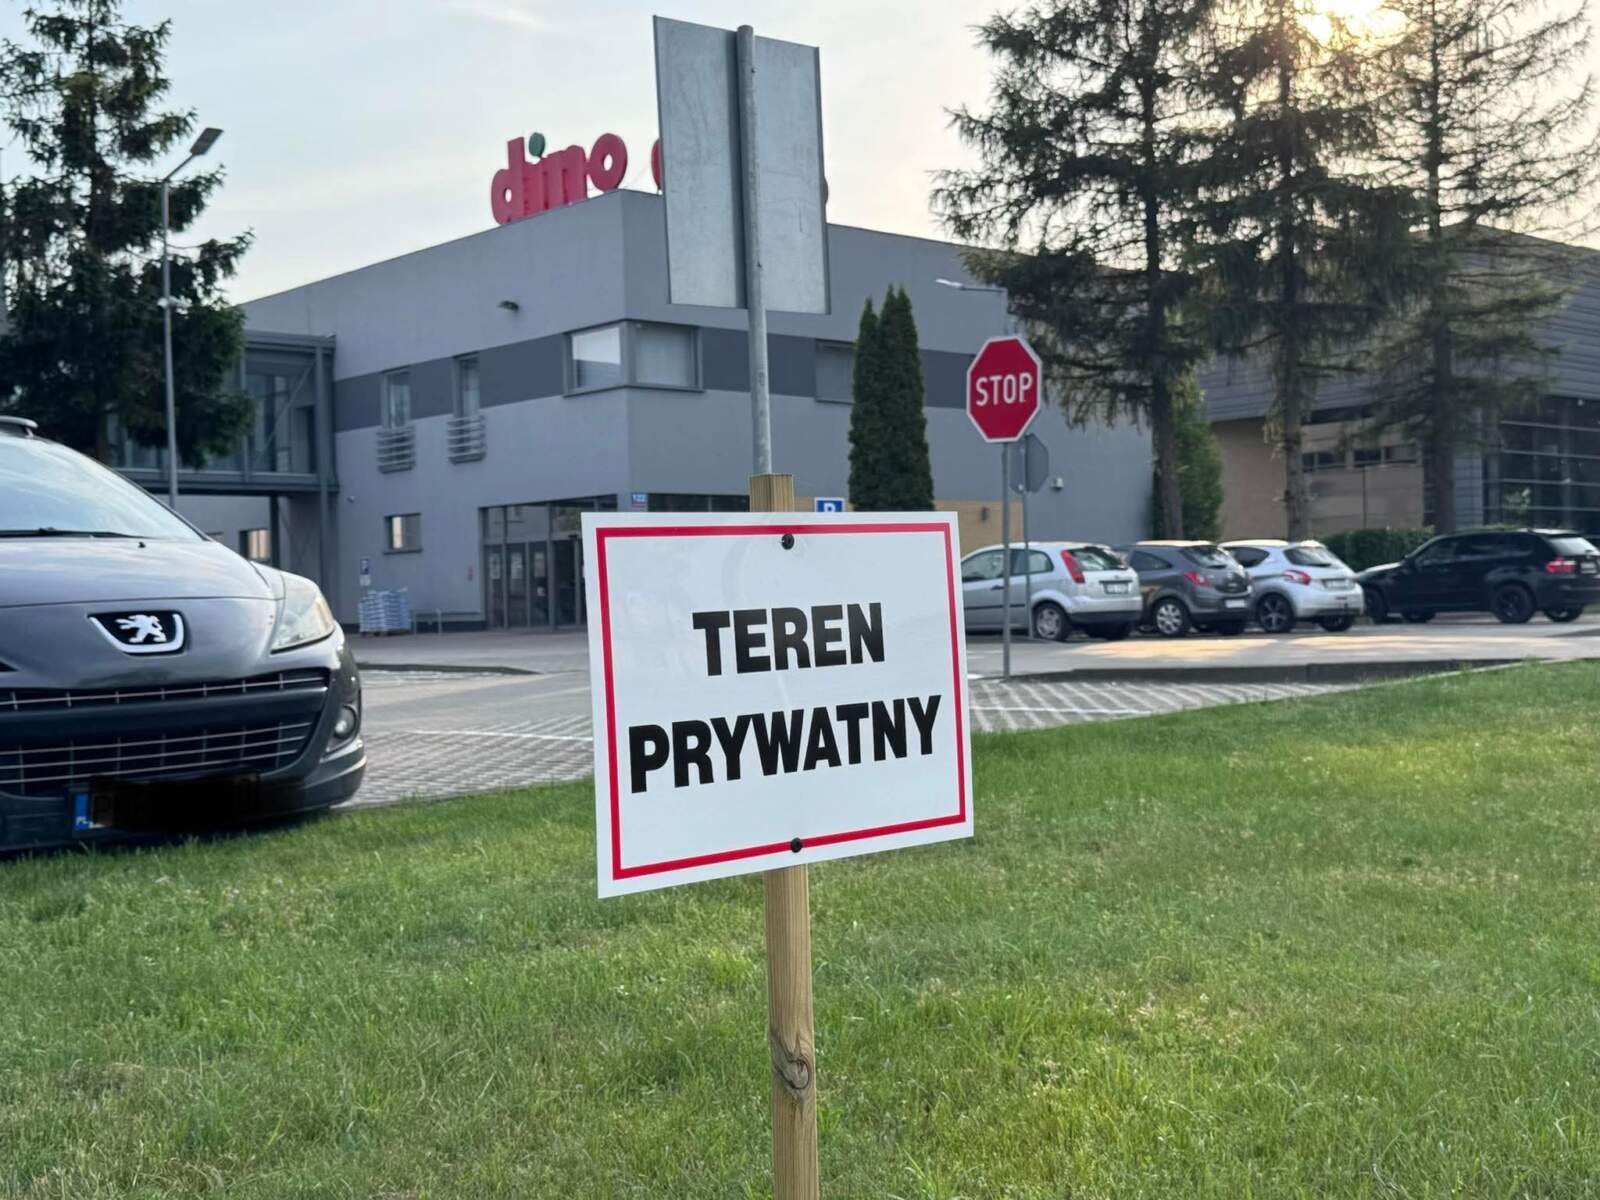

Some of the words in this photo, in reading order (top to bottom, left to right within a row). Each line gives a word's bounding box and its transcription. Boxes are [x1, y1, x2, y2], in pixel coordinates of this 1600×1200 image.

[491, 132, 628, 225] dino
[975, 372, 1033, 407] STOP
[692, 602, 885, 677] TEREN
[628, 694, 942, 794] PRYWATNY
